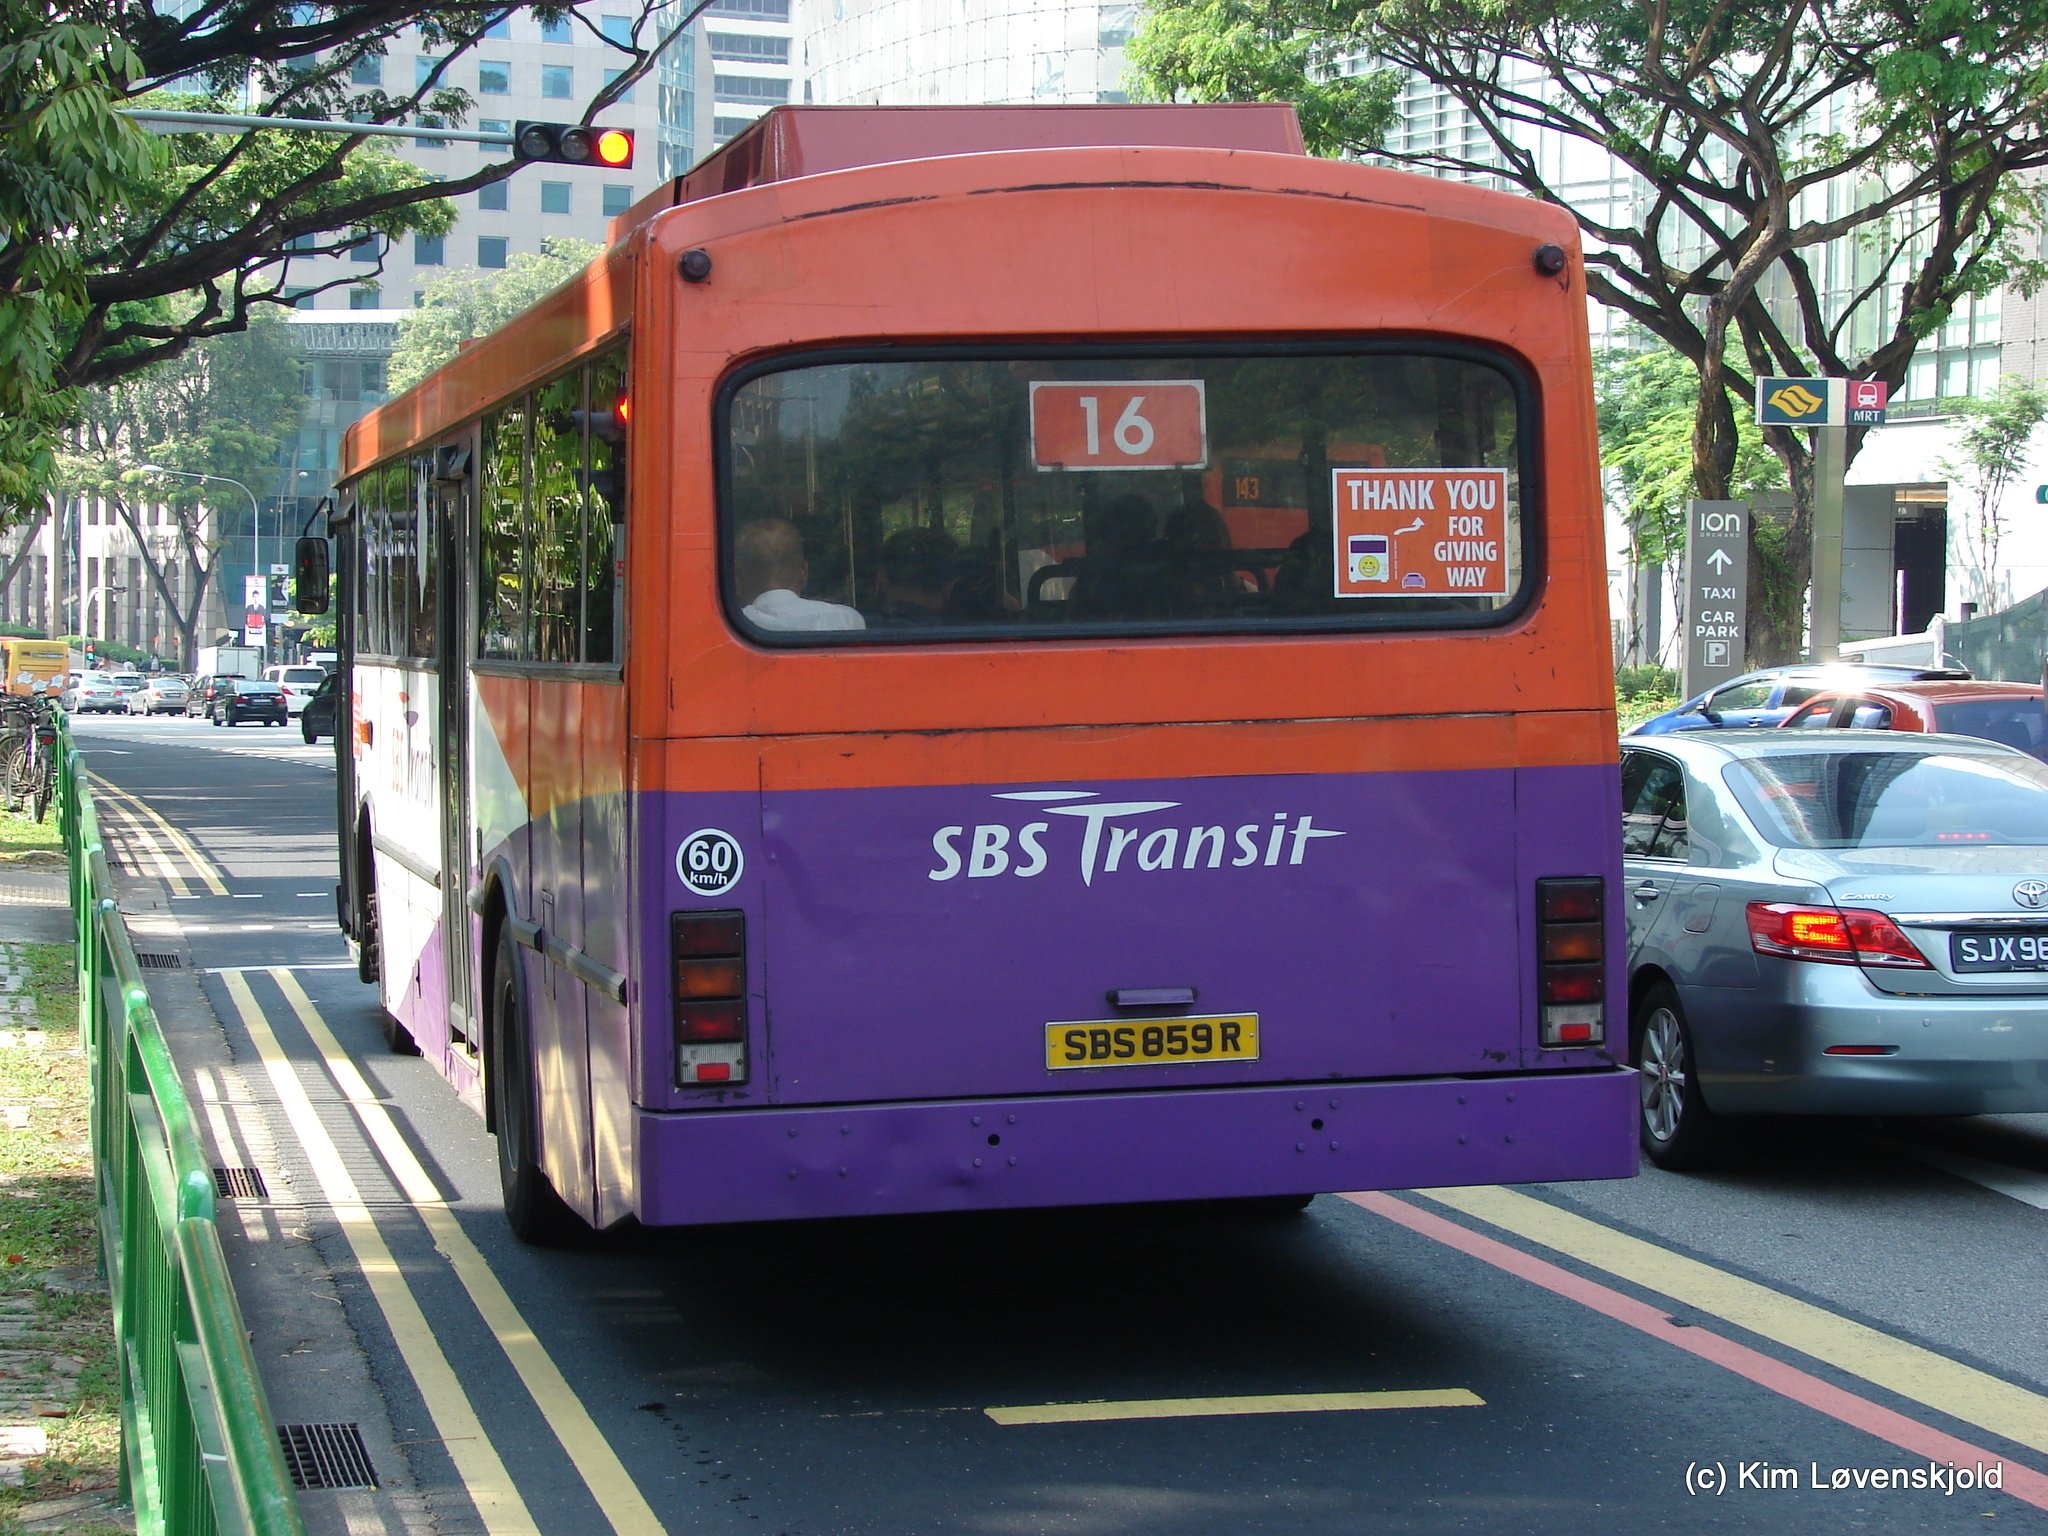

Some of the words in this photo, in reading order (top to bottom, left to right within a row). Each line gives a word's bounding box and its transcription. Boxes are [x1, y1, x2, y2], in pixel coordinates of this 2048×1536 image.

[1079, 396, 1155, 456] 16
[1853, 410, 1881, 422] MRT
[1234, 476, 1259, 500] 143
[1346, 479, 1435, 511] THANK
[1445, 479, 1496, 511] YOU
[1448, 516, 1484, 537] FOR
[1433, 541, 1498, 562] GIVING
[1446, 566, 1487, 588] WAY
[1701, 587, 1736, 600] TAXI
[1700, 610, 1735, 623] CAR
[1695, 625, 1739, 638] PARK
[1708, 642, 1726, 664] P
[928, 822, 1049, 882] SBS
[1042, 801, 1348, 888] Transit
[688, 839, 732, 872] 60
[690, 871, 728, 885] km/h
